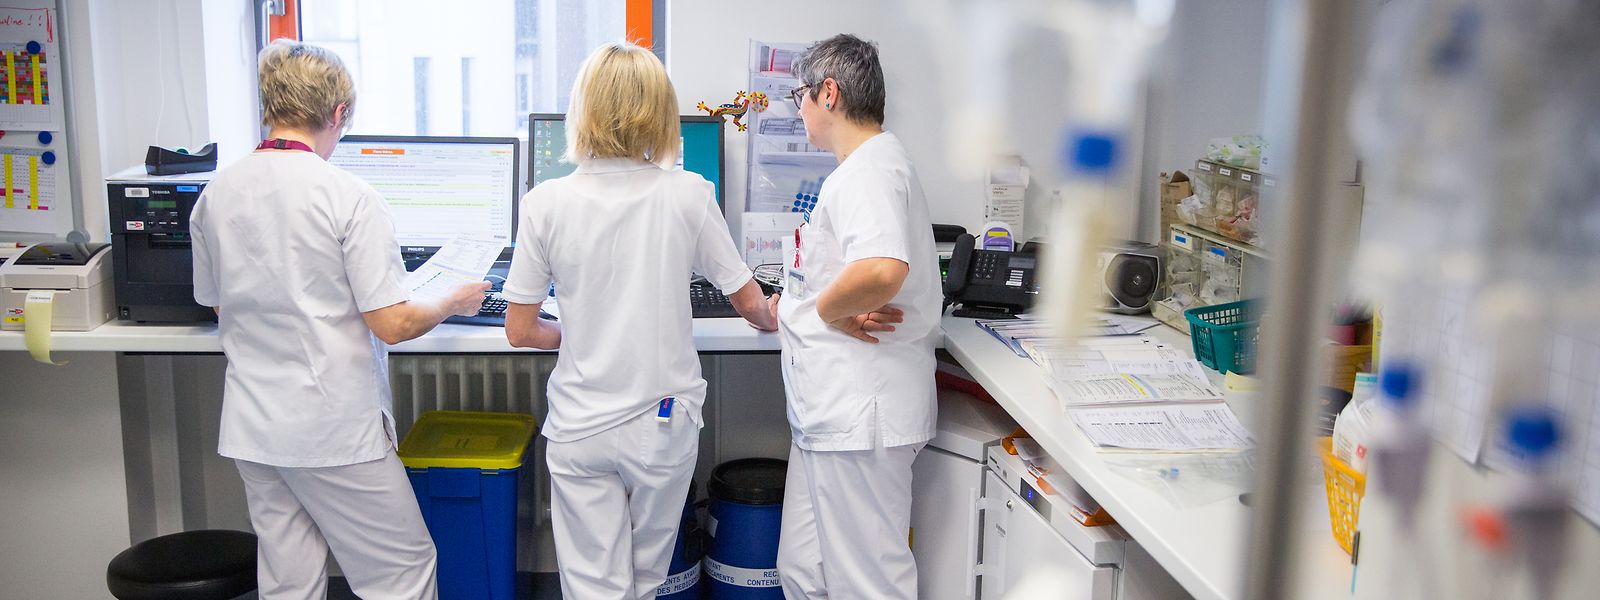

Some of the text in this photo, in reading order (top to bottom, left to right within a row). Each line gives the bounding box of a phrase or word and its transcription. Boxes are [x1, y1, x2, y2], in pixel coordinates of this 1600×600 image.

[763, 570, 779, 578] REC
[661, 576, 681, 586] ENTS
[657, 586, 671, 595] DES
